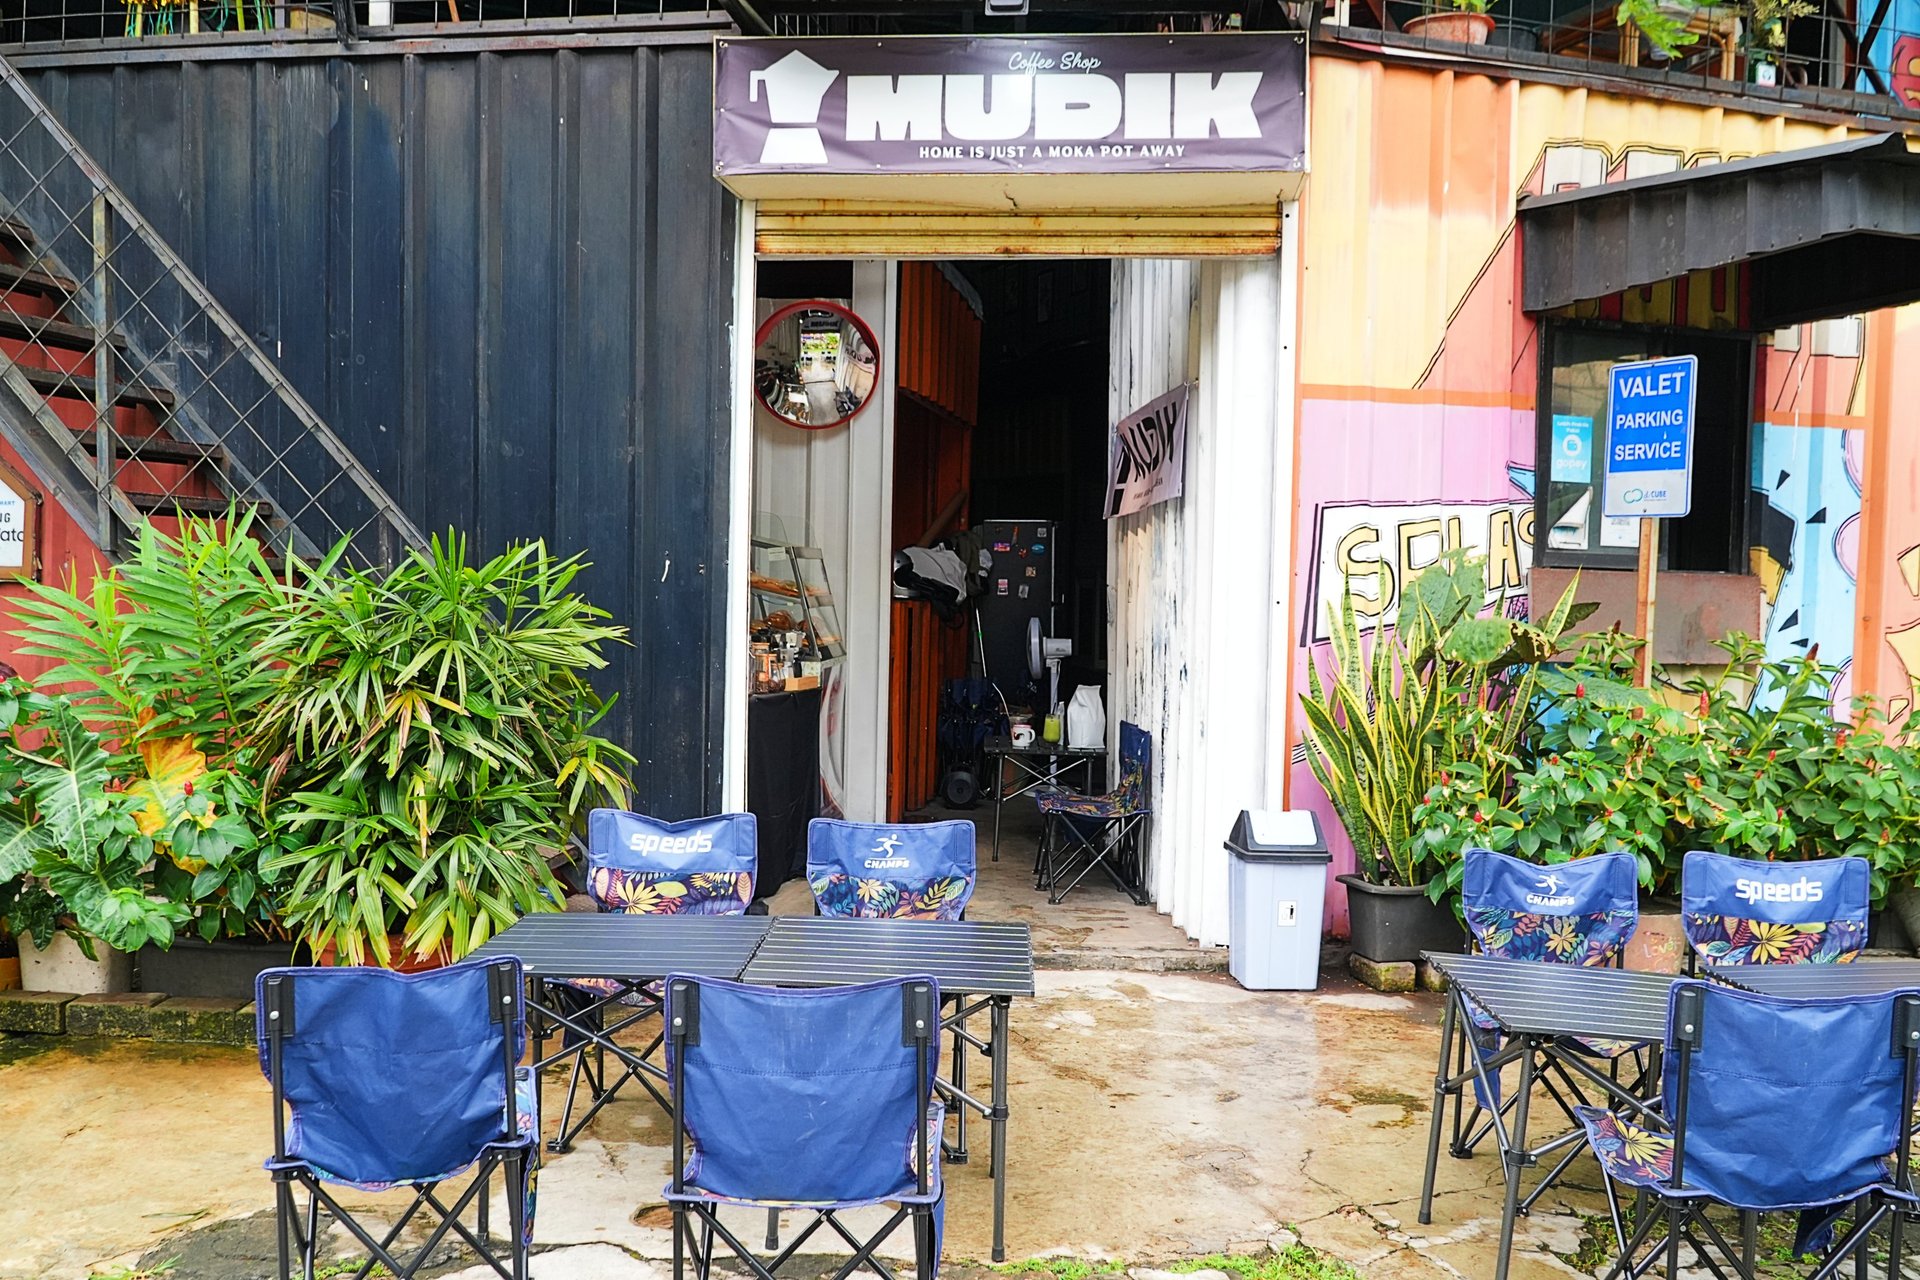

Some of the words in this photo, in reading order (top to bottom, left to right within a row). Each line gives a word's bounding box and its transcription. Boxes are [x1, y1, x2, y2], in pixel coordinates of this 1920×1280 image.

[1008, 52, 1055, 77] Coffee
[1059, 52, 1101, 75] Shop
[846, 72, 1263, 141] MUDIK
[919, 146, 963, 159] HOME
[970, 146, 985, 159] IS
[989, 146, 1026, 160] JUST
[1032, 146, 1042, 158] A
[1048, 145, 1095, 158] MOKA
[1101, 145, 1133, 157] POT
[1140, 145, 1185, 157] AWAY
[1619, 371, 1686, 399] VALET
[1616, 409, 1683, 430] PARKING
[1614, 441, 1681, 461] SERVICE
[630, 830, 713, 856] speeds
[864, 859, 910, 869] CHAMPS
[1526, 894, 1575, 907] CHAMPS
[1735, 877, 1823, 904] speeds
